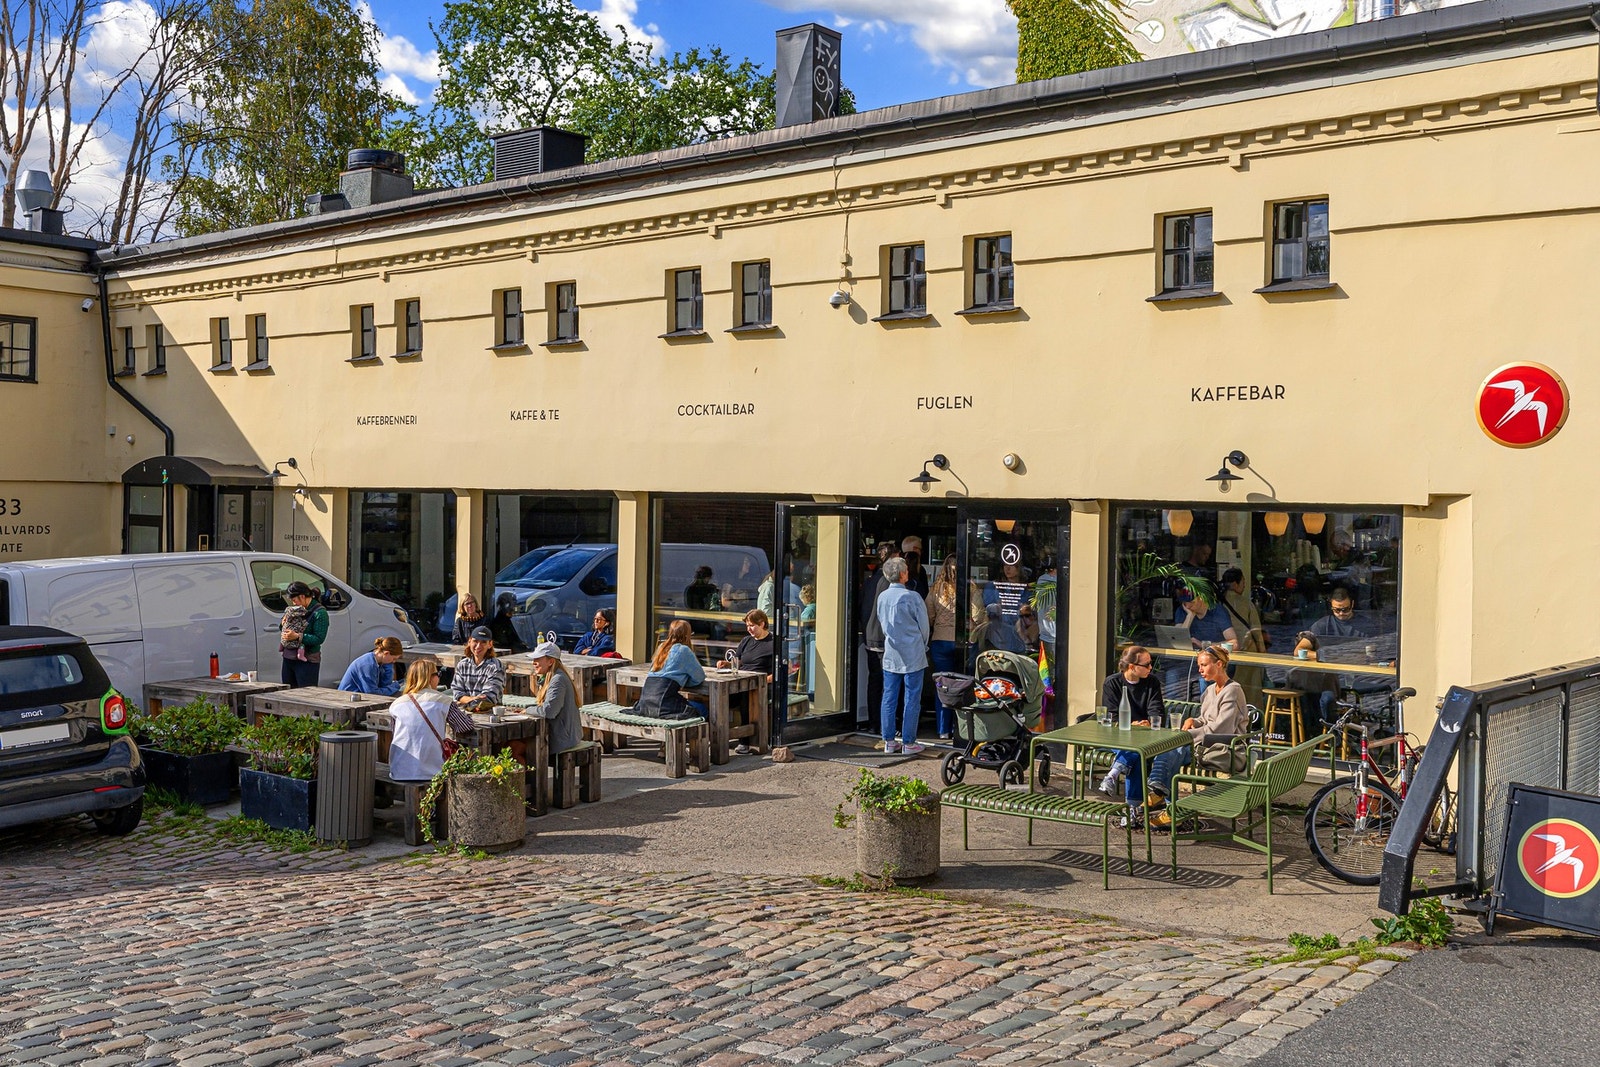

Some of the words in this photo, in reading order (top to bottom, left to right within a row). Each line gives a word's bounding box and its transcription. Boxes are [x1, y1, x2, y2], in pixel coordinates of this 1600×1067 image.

[1191, 384, 1285, 402] KAFFEBAR
[677, 402, 755, 416] COCKTAILBAR
[917, 395, 973, 410] FUGLEN
[356, 415, 418, 426] KAFFEBRENNERI
[510, 410, 538, 421] KAFFE
[540, 409, 546, 420] &
[548, 409, 560, 420] TE
[20, 709, 43, 719] smart
